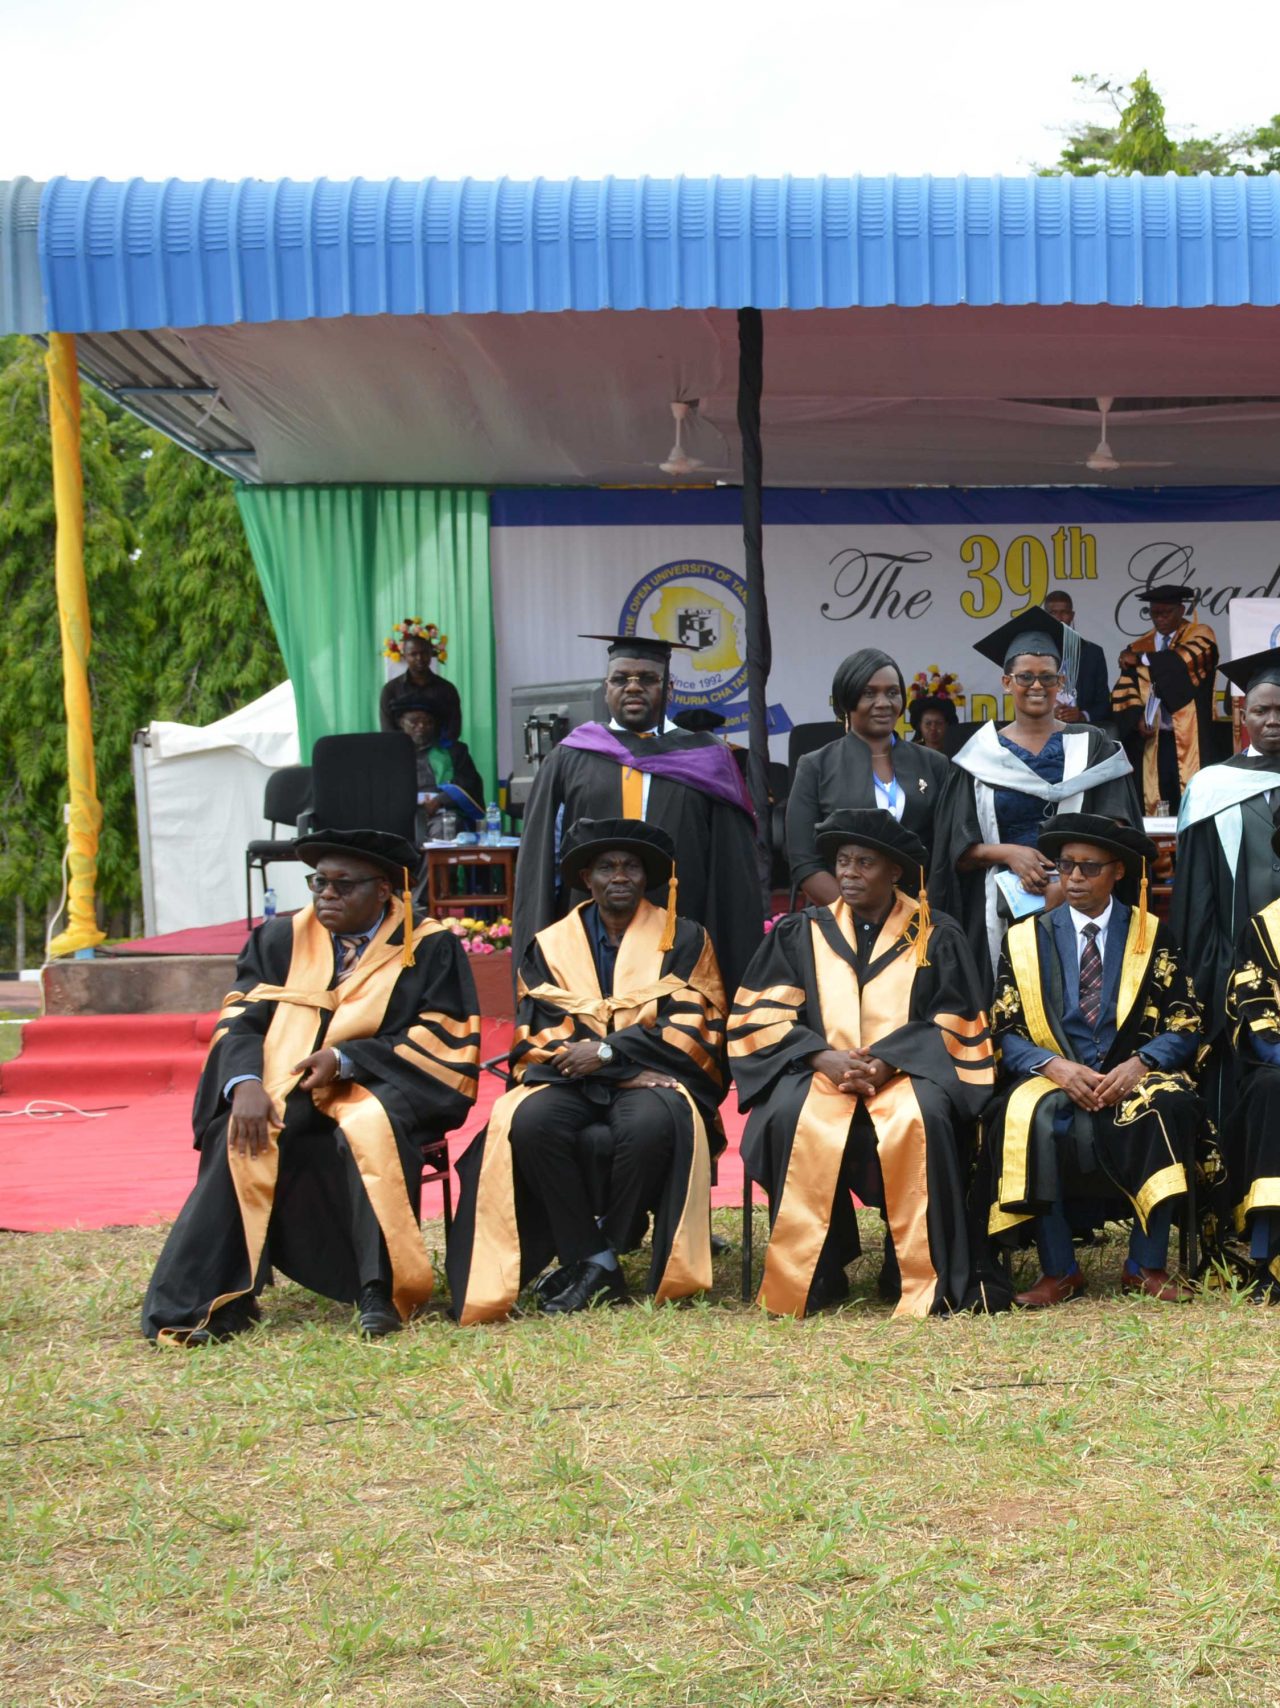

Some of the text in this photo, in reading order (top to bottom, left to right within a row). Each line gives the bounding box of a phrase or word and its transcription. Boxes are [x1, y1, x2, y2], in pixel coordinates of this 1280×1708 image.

[629, 582, 652, 612] OPEN
[650, 563, 715, 586] UNIVERSITY
[716, 568, 732, 583] OF
[820, 548, 933, 621] The
[959, 525, 1099, 619] 39th
[674, 686, 734, 706] HURIA CHA
[699, 672, 724, 689] 1992
